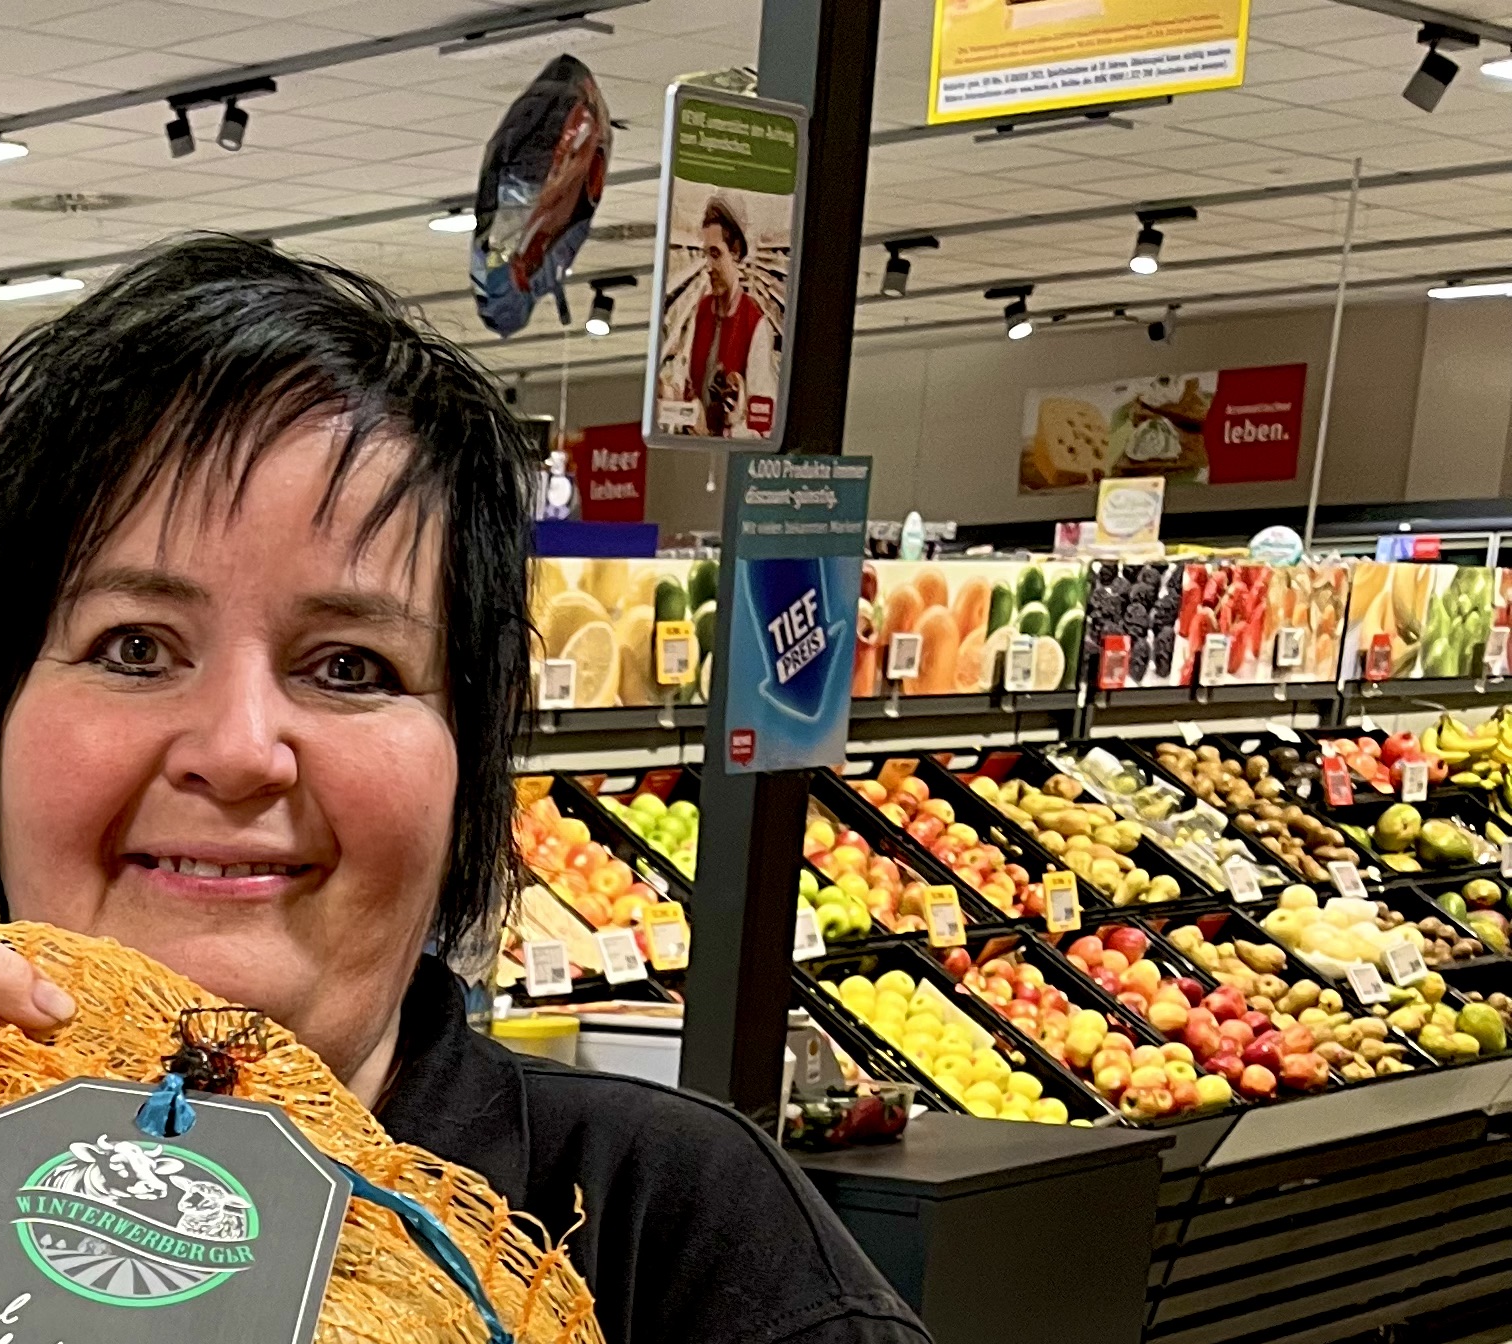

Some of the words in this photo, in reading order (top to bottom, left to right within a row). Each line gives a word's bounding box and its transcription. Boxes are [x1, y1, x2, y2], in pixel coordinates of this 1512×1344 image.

[1224, 418, 1290, 444] leben.
[768, 588, 818, 654] TIEF
[780, 630, 824, 677] PREIS
[15, 1194, 204, 1263] WINTERWERBER
[208, 1243, 256, 1265] GbR
